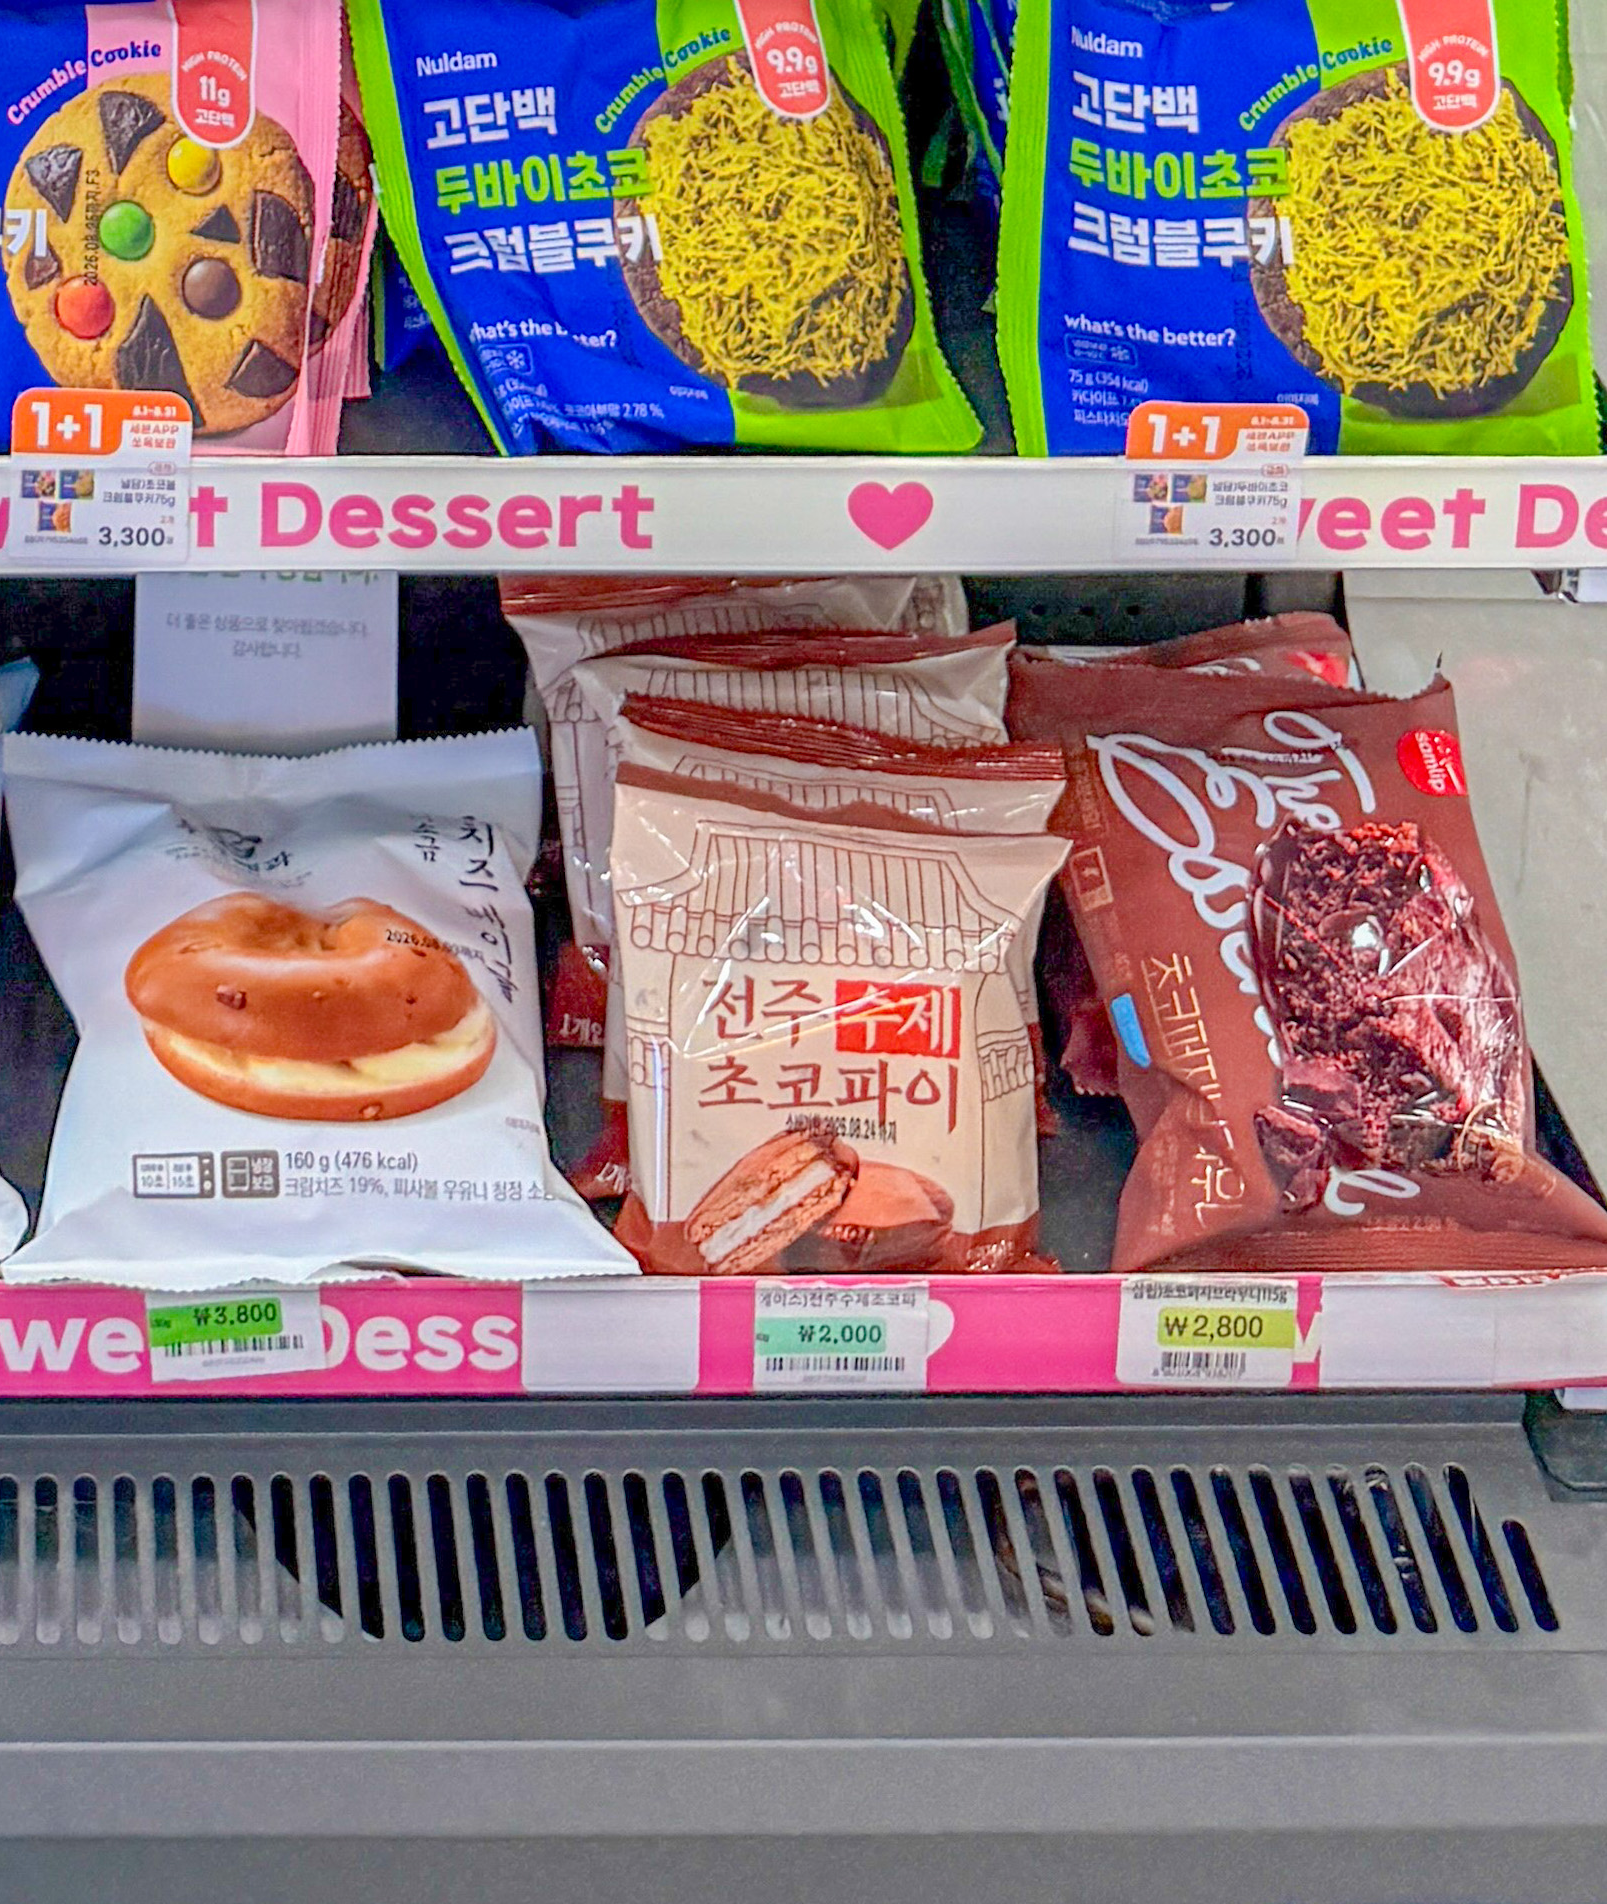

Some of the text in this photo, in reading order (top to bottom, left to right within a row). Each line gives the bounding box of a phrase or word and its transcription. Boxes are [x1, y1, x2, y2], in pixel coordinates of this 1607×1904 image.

[416, 49, 498, 77] Nuldam
[1238, 36, 1393, 132] Crumble Cookie
[423, 86, 558, 150] 고단백
[1071, 71, 1199, 134] 고단백
[436, 148, 652, 215] 두바이초코
[1069, 142, 1289, 200] 두바이초코
[444, 213, 663, 275] 크럼블쿠키
[1067, 201, 1294, 268] 크럼블쿠키
[1065, 313, 1236, 350] what's the better?
[31, 402, 102, 450] 1+1
[1146, 415, 1220, 453] 1+1
[260, 482, 656, 551] Dessert
[703, 978, 959, 1056] 전주 수제
[698, 1058, 961, 1134] 초코파이
[285, 1151, 316, 1170] 160
[335, 1150, 374, 1173] (476
[378, 1150, 418, 1173] kcal)
[285, 1177, 387, 1198] 크림치즈 19%,
